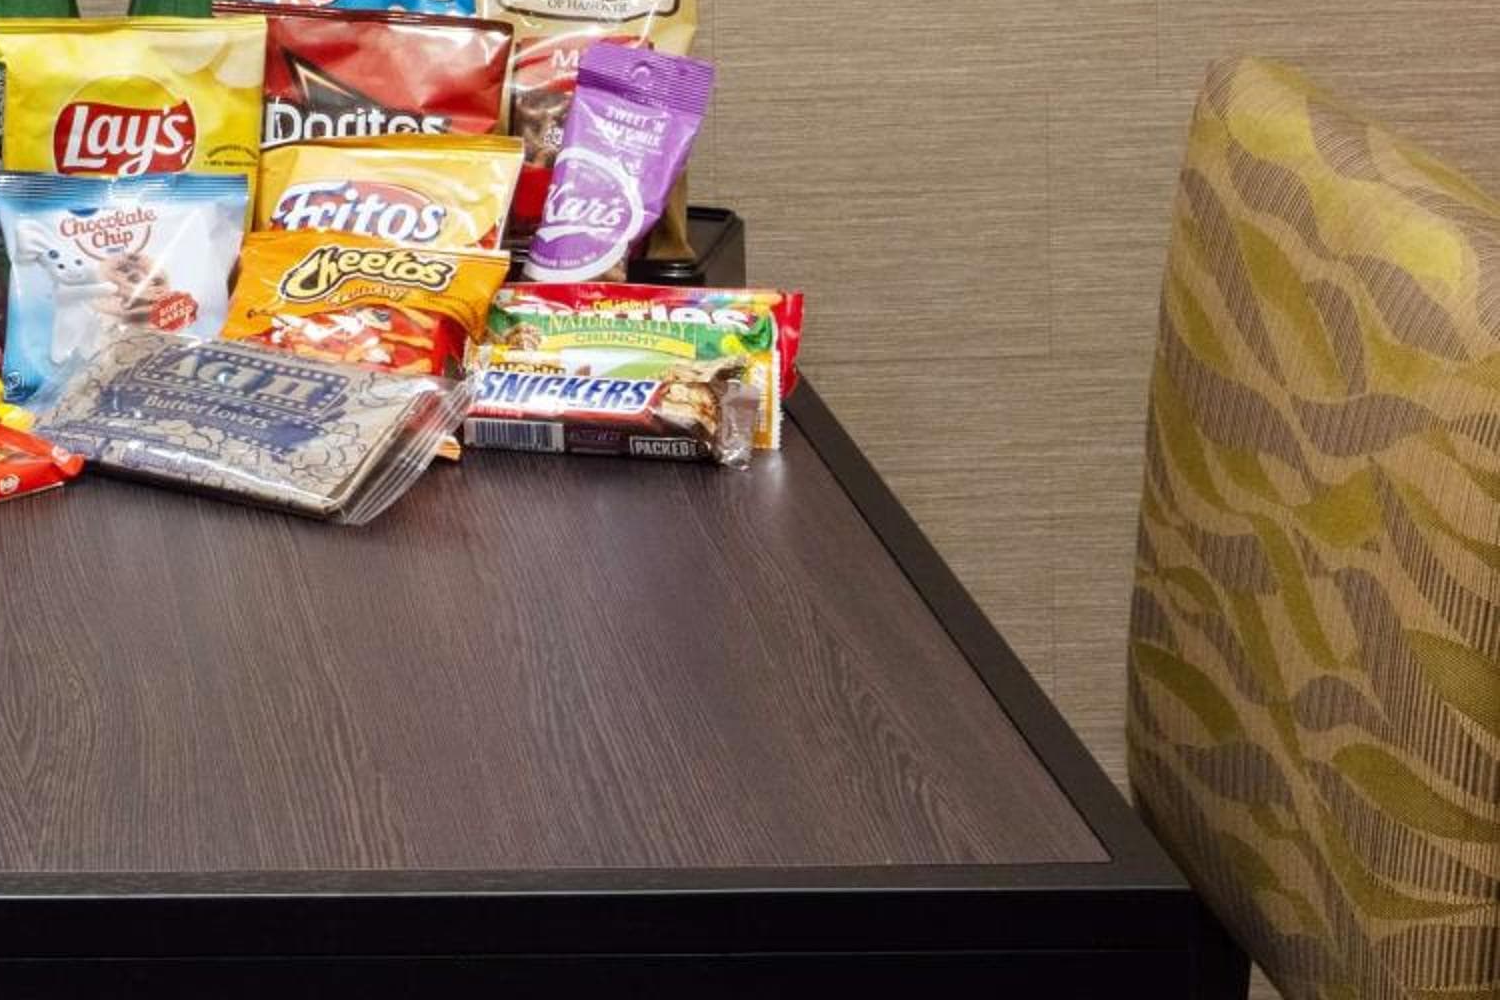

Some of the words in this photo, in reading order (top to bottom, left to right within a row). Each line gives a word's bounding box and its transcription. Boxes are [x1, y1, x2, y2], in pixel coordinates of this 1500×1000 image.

[64, 104, 188, 176] Lay's
[59, 206, 157, 238] Chocolate
[271, 180, 446, 242] Fritos
[91, 227, 134, 249] Chip
[280, 246, 456, 301] Cheetos
[575, 332, 661, 347] CRUNCHY
[479, 371, 657, 408] SNICKERS
[144, 394, 208, 416] Butter
[208, 407, 272, 430] Lovers
